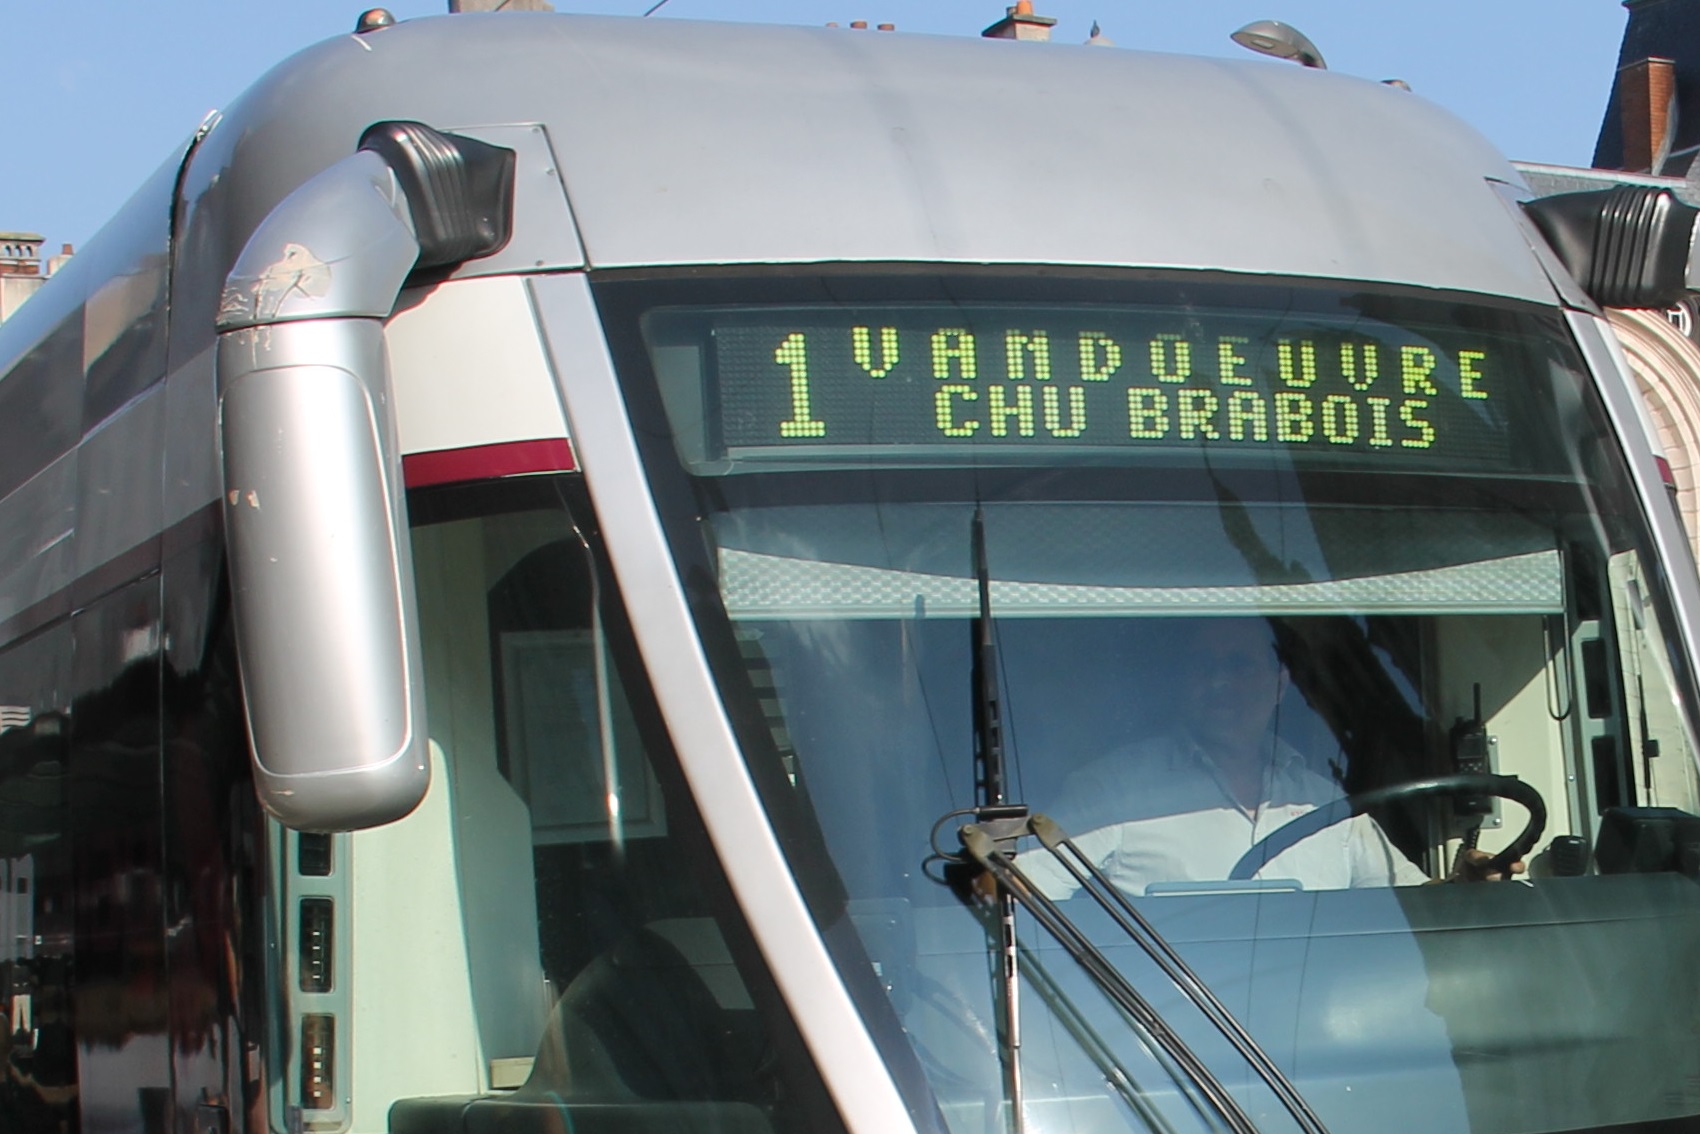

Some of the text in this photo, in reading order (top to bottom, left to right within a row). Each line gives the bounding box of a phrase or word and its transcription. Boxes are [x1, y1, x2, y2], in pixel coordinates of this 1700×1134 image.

[775, 333, 826, 438] 1
[852, 327, 1489, 399] VANDOEUVRE
[935, 384, 1437, 448] CHU BRABOIS
